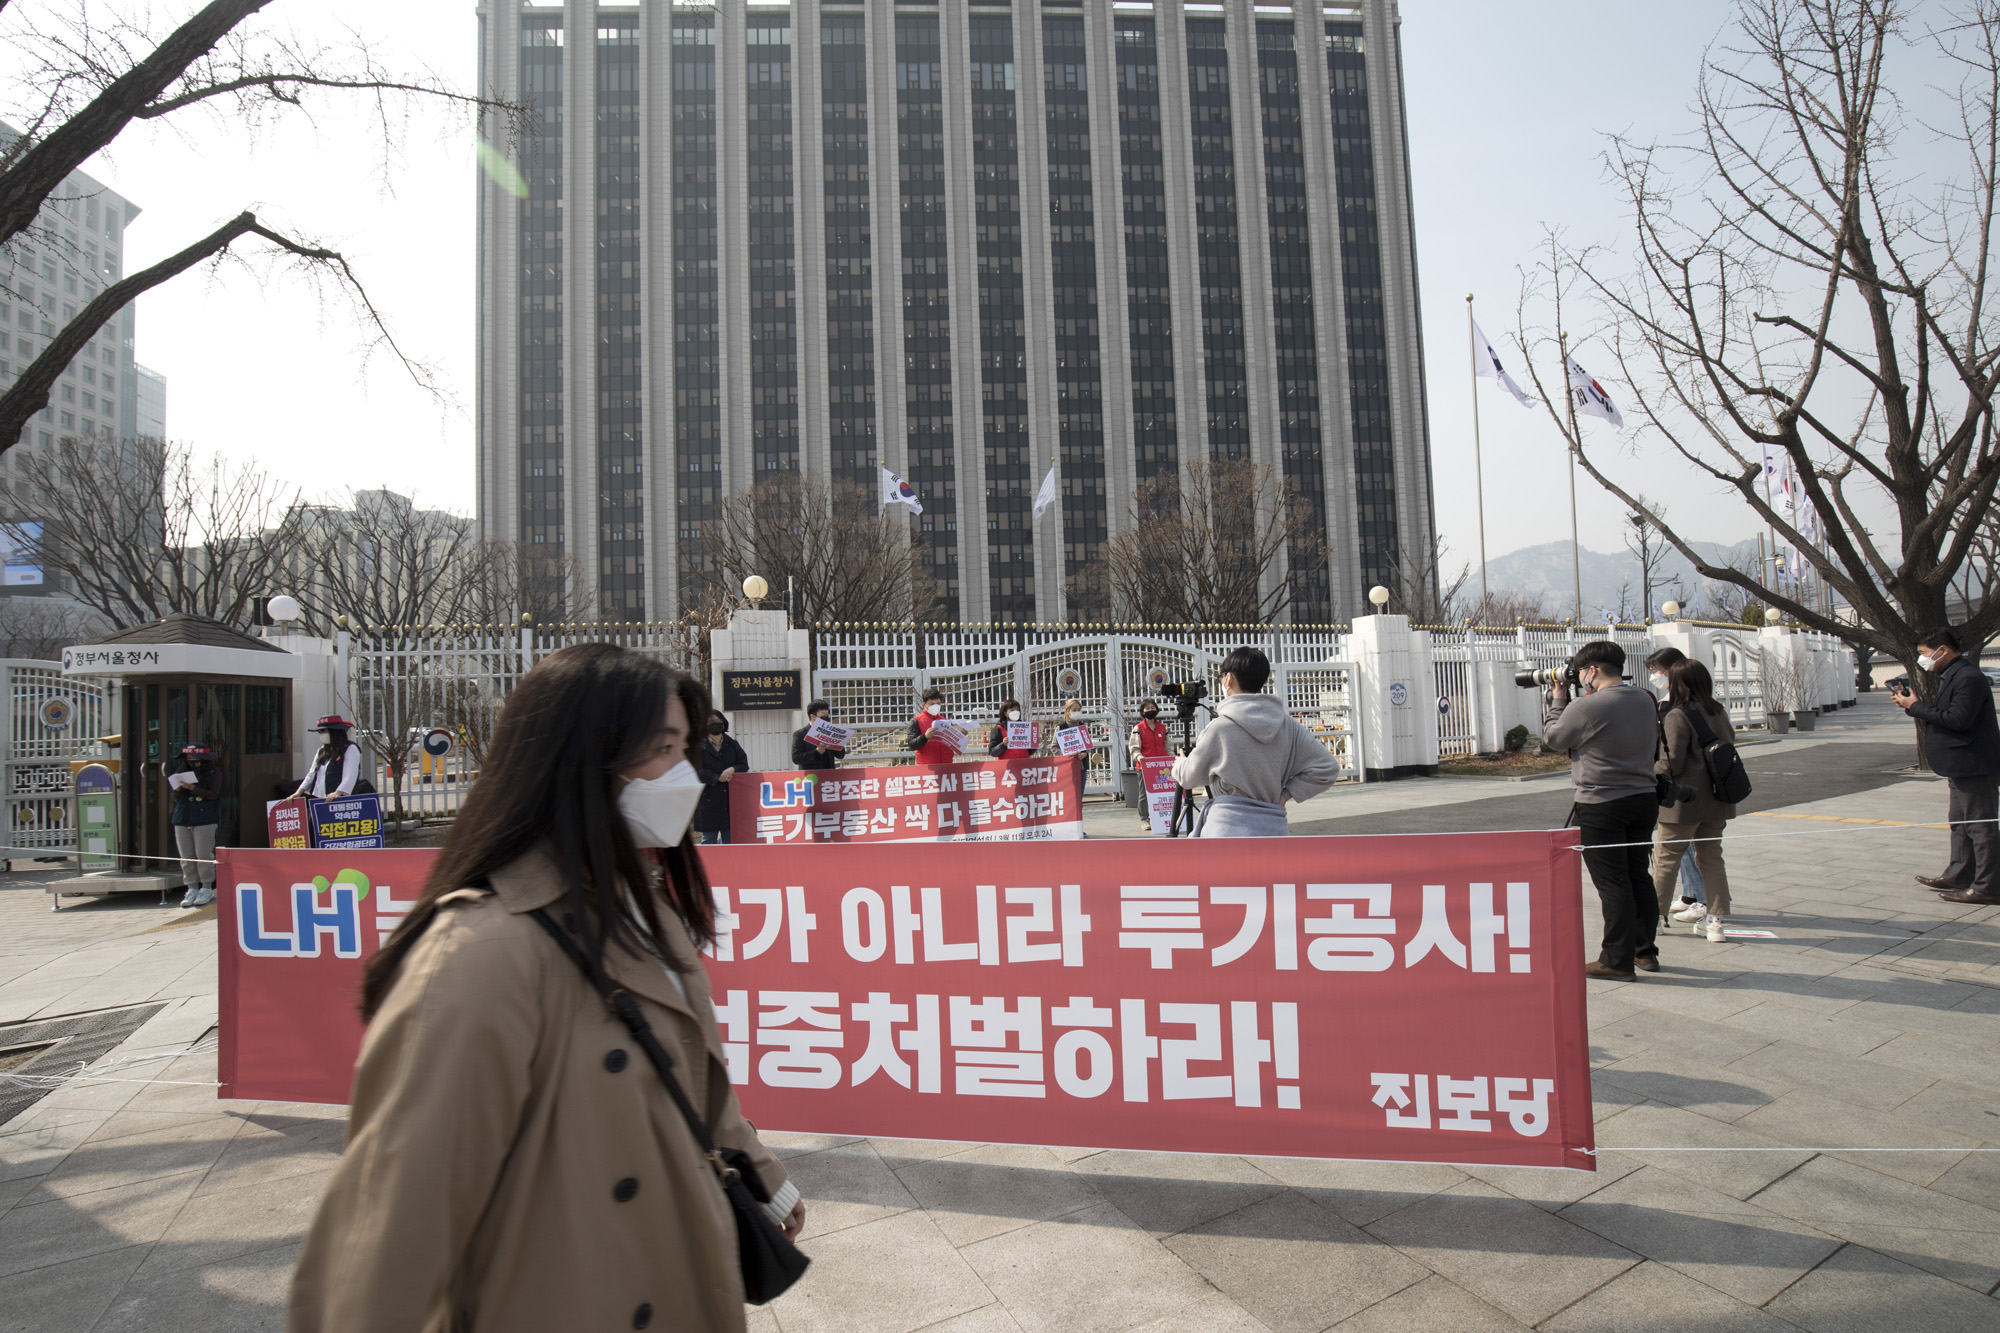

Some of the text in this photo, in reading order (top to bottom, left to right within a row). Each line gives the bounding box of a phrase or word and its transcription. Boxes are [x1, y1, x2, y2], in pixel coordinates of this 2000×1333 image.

[75, 651, 159, 666] 정부서울청사
[731, 676, 793, 688] 정부서울청사
[821, 778, 880, 802] 합조단
[885, 773, 957, 798] 셀프조사
[961, 770, 996, 792] 믿을
[1001, 769, 1017, 788] 수
[1021, 766, 1058, 786] 없다!
[275, 807, 299, 820] 최저시급
[329, 802, 362, 812] 대통령이
[334, 811, 360, 820] 약속한
[756, 791, 1064, 844] 투기부동산 싹 다 몰수하라!
[276, 819, 301, 832] 못참겠다
[320, 819, 378, 838] 직접고용!
[1026, 830, 1040, 839] 오후
[1041, 829, 1053, 838] 2시
[273, 835, 306, 848] 생활임금
[840, 884, 1092, 967] 아니라
[1119, 882, 1531, 974] 투기공사!
[1370, 1072, 1555, 1137] 진보당
